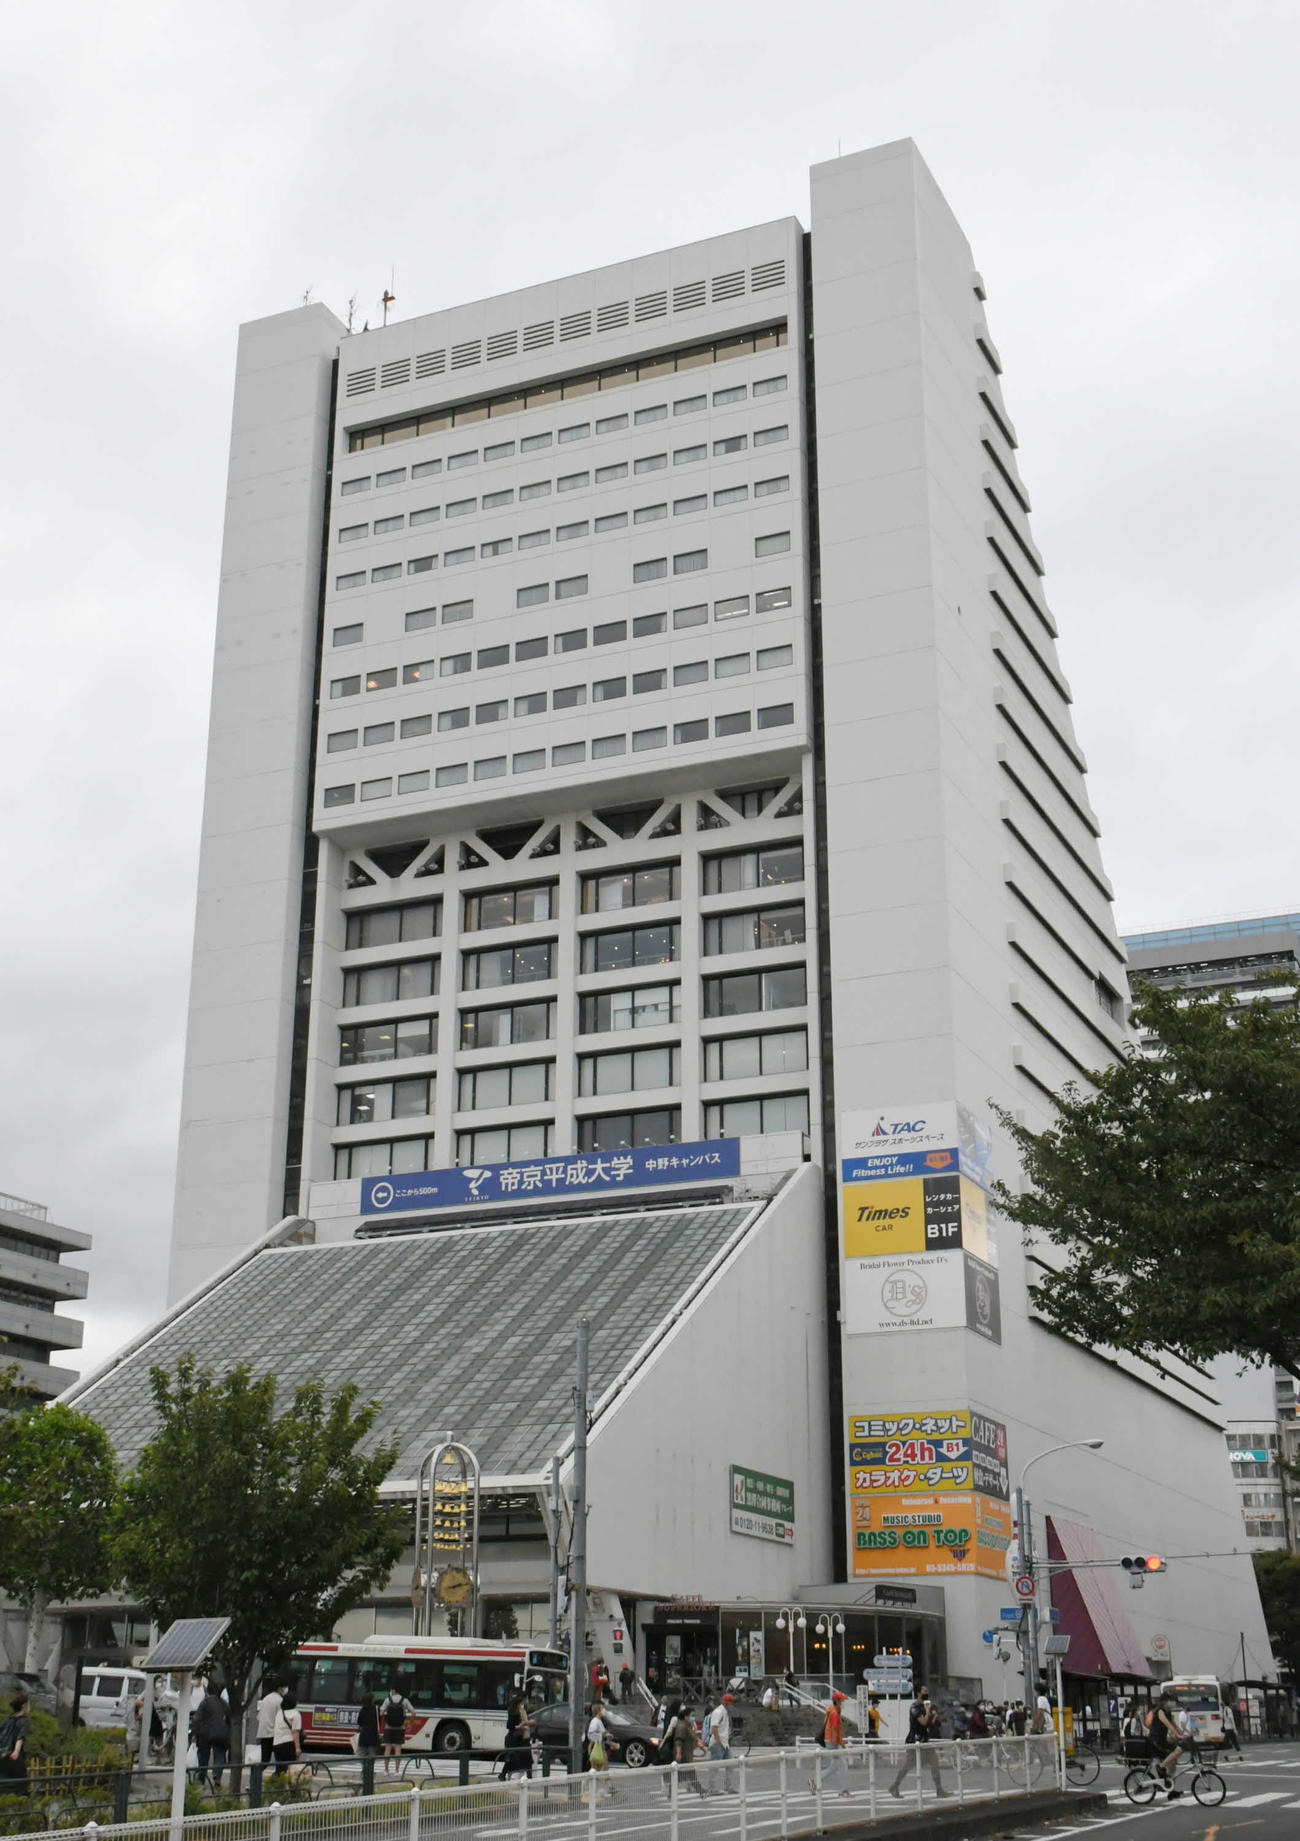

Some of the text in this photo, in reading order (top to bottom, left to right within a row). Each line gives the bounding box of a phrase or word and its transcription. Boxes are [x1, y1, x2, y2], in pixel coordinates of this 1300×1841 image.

[890, 1120, 926, 1135] TAC
[645, 1152, 721, 1171] 中野キャンパス
[867, 1156, 898, 1167] ENJOY
[499, 1156, 634, 1192] 帝京平成大学
[852, 1164, 914, 1178] Fitness Life!!
[925, 1193, 960, 1202] レンタカー
[857, 1205, 911, 1222] Times
[926, 1205, 960, 1214] カーシェア
[875, 1224, 893, 1233] CAR
[927, 1223, 959, 1238] B1F
[860, 1261, 881, 1270] Bridal
[882, 1260, 906, 1269] Flower
[907, 1257, 935, 1267] Produce
[855, 1415, 967, 1437] コミック・ネット
[971, 1416, 996, 1448] CAFE
[886, 1440, 936, 1465] 24h
[946, 1441, 960, 1452] B1
[856, 1466, 968, 1489] カラオケ・ダーツ
[882, 1514, 910, 1526] MUSIC
[911, 1513, 942, 1525] STUDIO
[856, 1529, 970, 1549] BASS ON TOP
